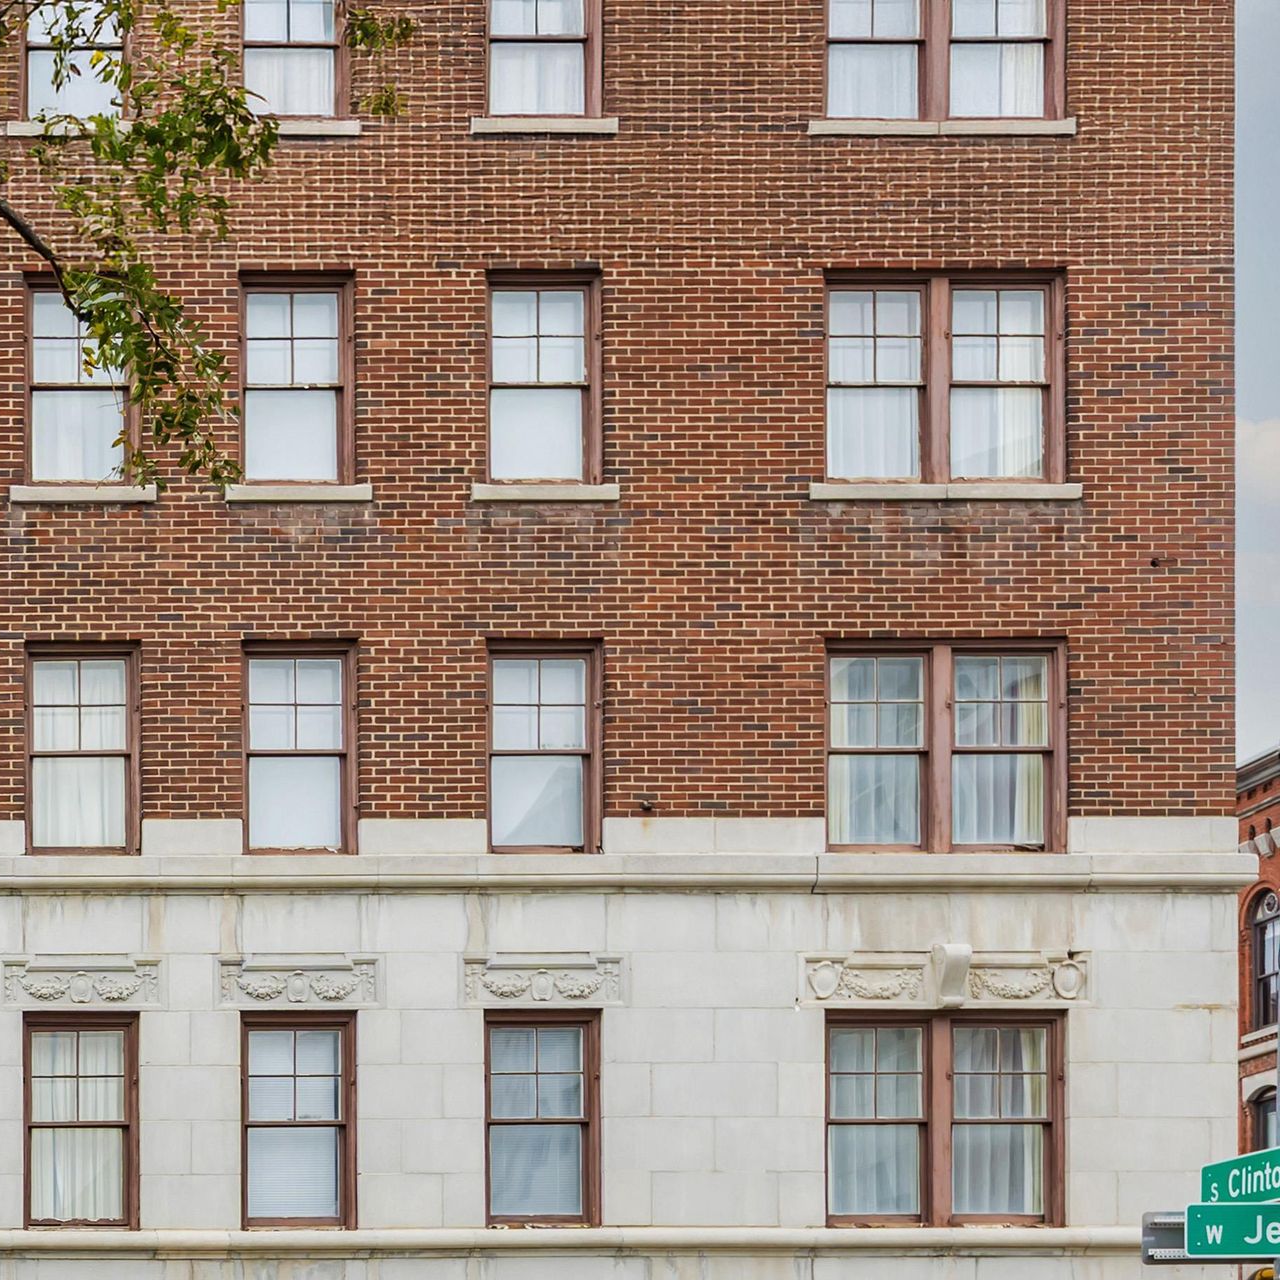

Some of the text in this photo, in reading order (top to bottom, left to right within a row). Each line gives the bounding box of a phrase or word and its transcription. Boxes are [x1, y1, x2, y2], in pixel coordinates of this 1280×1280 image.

[1210, 1161, 1280, 1202] S Clinto
[1205, 1214, 1280, 1245] W Je
